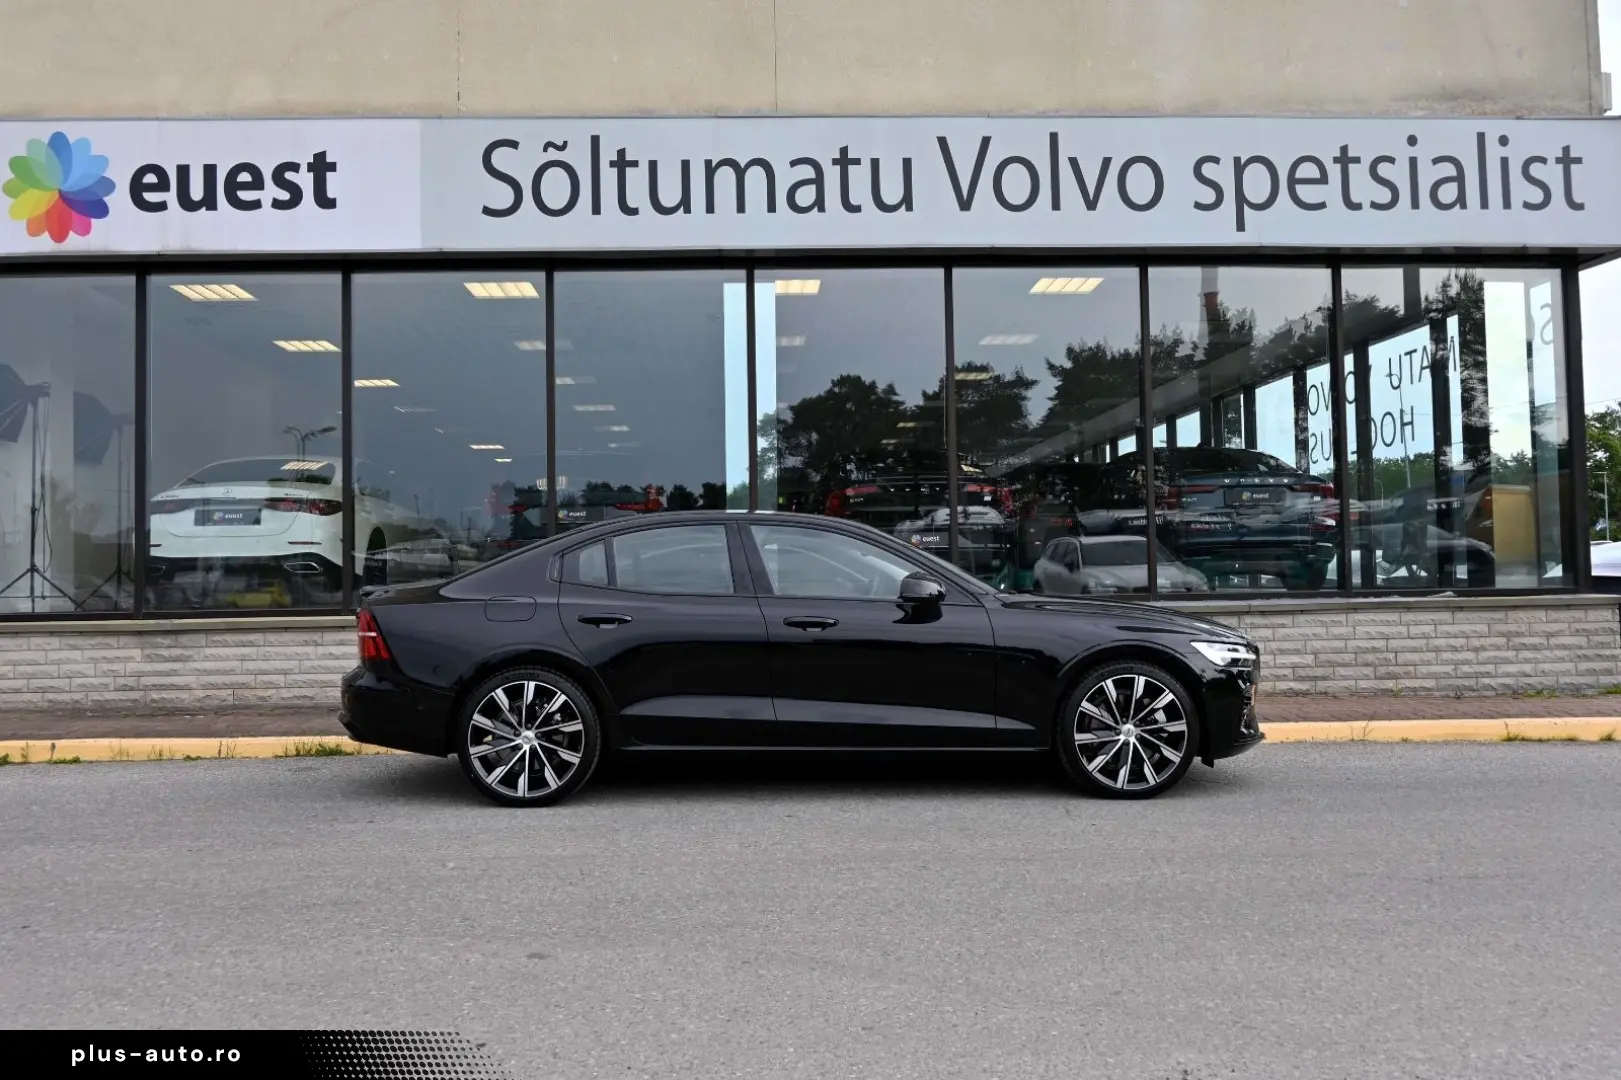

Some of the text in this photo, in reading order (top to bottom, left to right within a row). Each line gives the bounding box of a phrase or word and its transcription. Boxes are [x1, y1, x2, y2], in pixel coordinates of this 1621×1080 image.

[130, 151, 337, 213] euest
[482, 132, 1585, 232] Sõltumatu Volvo spetsialist
